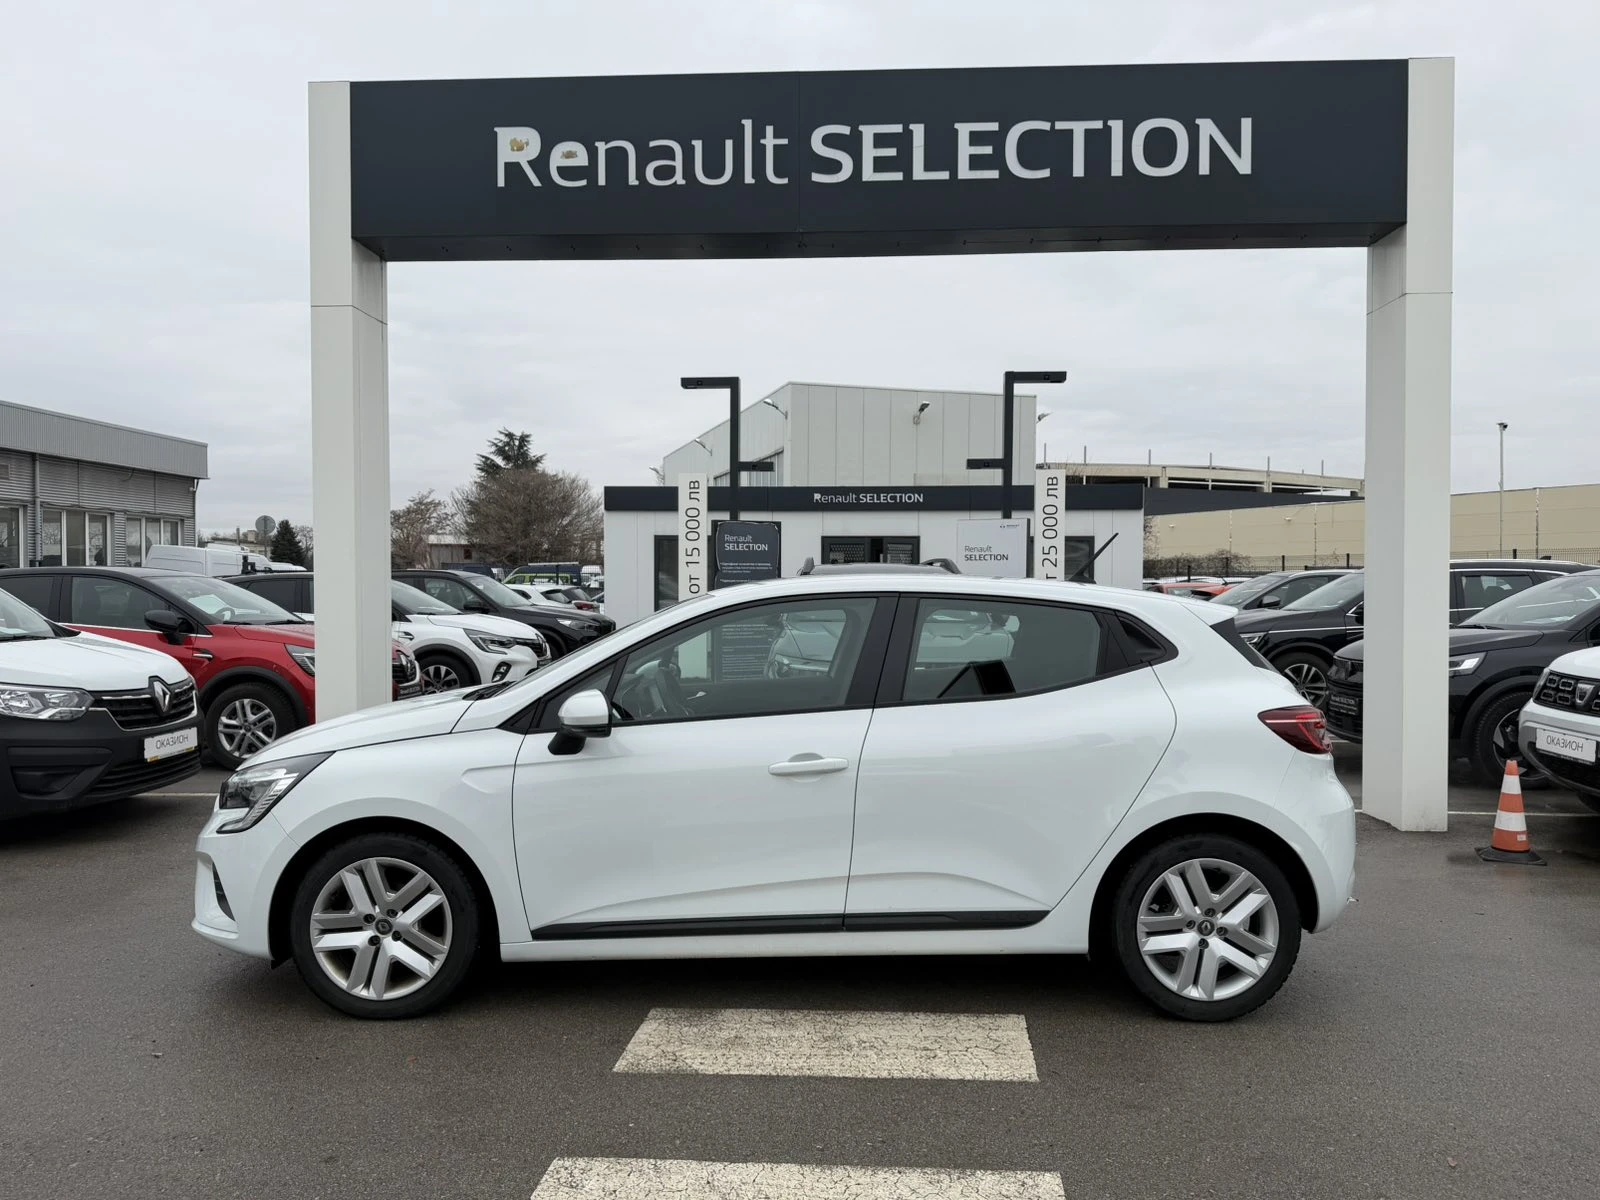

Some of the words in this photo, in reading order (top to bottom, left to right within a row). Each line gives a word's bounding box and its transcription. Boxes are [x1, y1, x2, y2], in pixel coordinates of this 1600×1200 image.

[494, 118, 789, 188] Renault
[810, 117, 1253, 184] SELECTION
[813, 493, 857, 503] Renault
[860, 493, 924, 503] SELECTION
[685, 507, 701, 542] 000
[1042, 504, 1059, 540] 000
[724, 533, 753, 543] Renault
[724, 543, 768, 551] SELECTION
[964, 545, 992, 553] Renault
[685, 547, 701, 568] 15
[964, 554, 1009, 562] SELECTION
[1042, 545, 1058, 568] 25
[155, 735, 189, 749] ОКАЗИОН
[1546, 735, 1584, 752] ОКАЗИОН
